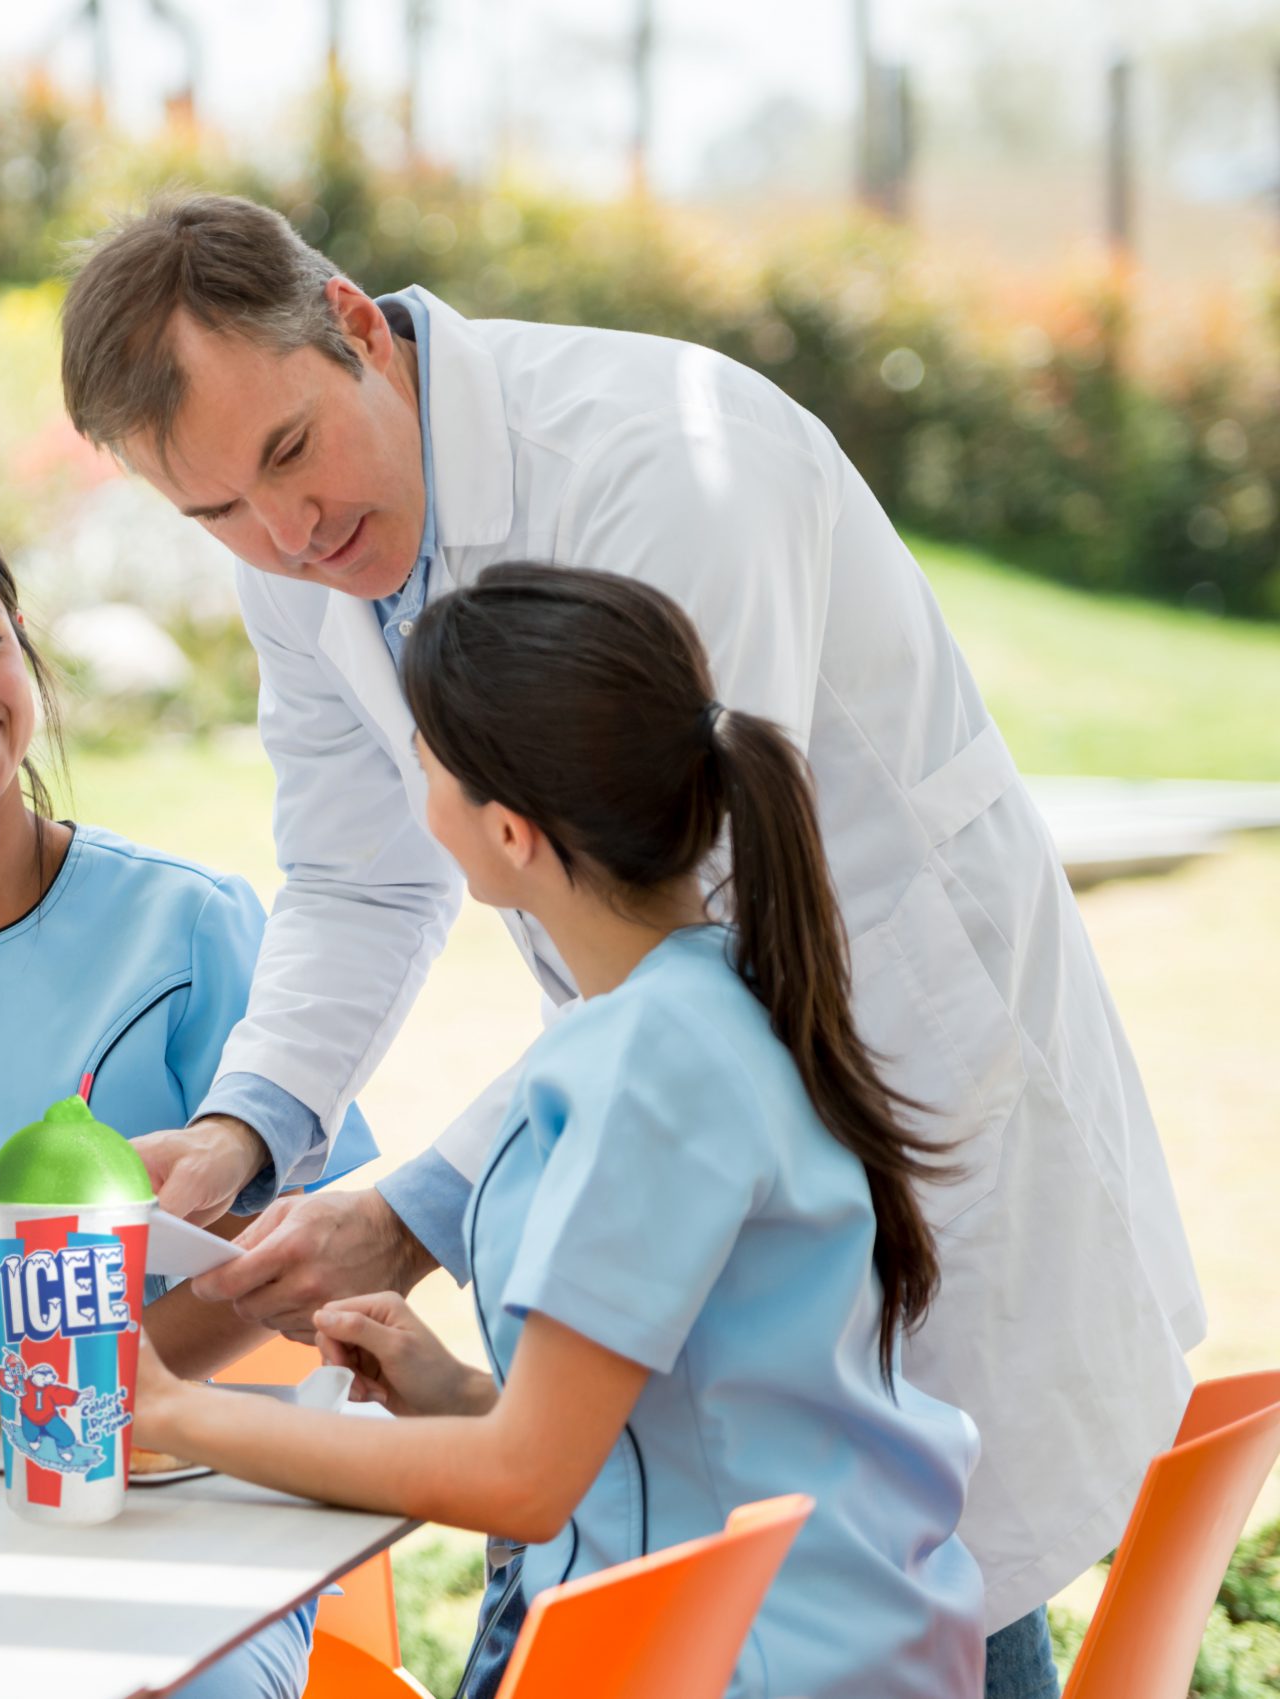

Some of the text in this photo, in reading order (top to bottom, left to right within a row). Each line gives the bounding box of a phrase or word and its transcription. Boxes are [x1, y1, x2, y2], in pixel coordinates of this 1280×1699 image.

[0, 1245, 129, 1342] ICEE
[81, 1388, 126, 1417] Coldest
[90, 1403, 122, 1429] Drink
[102, 1413, 131, 1434] Town
